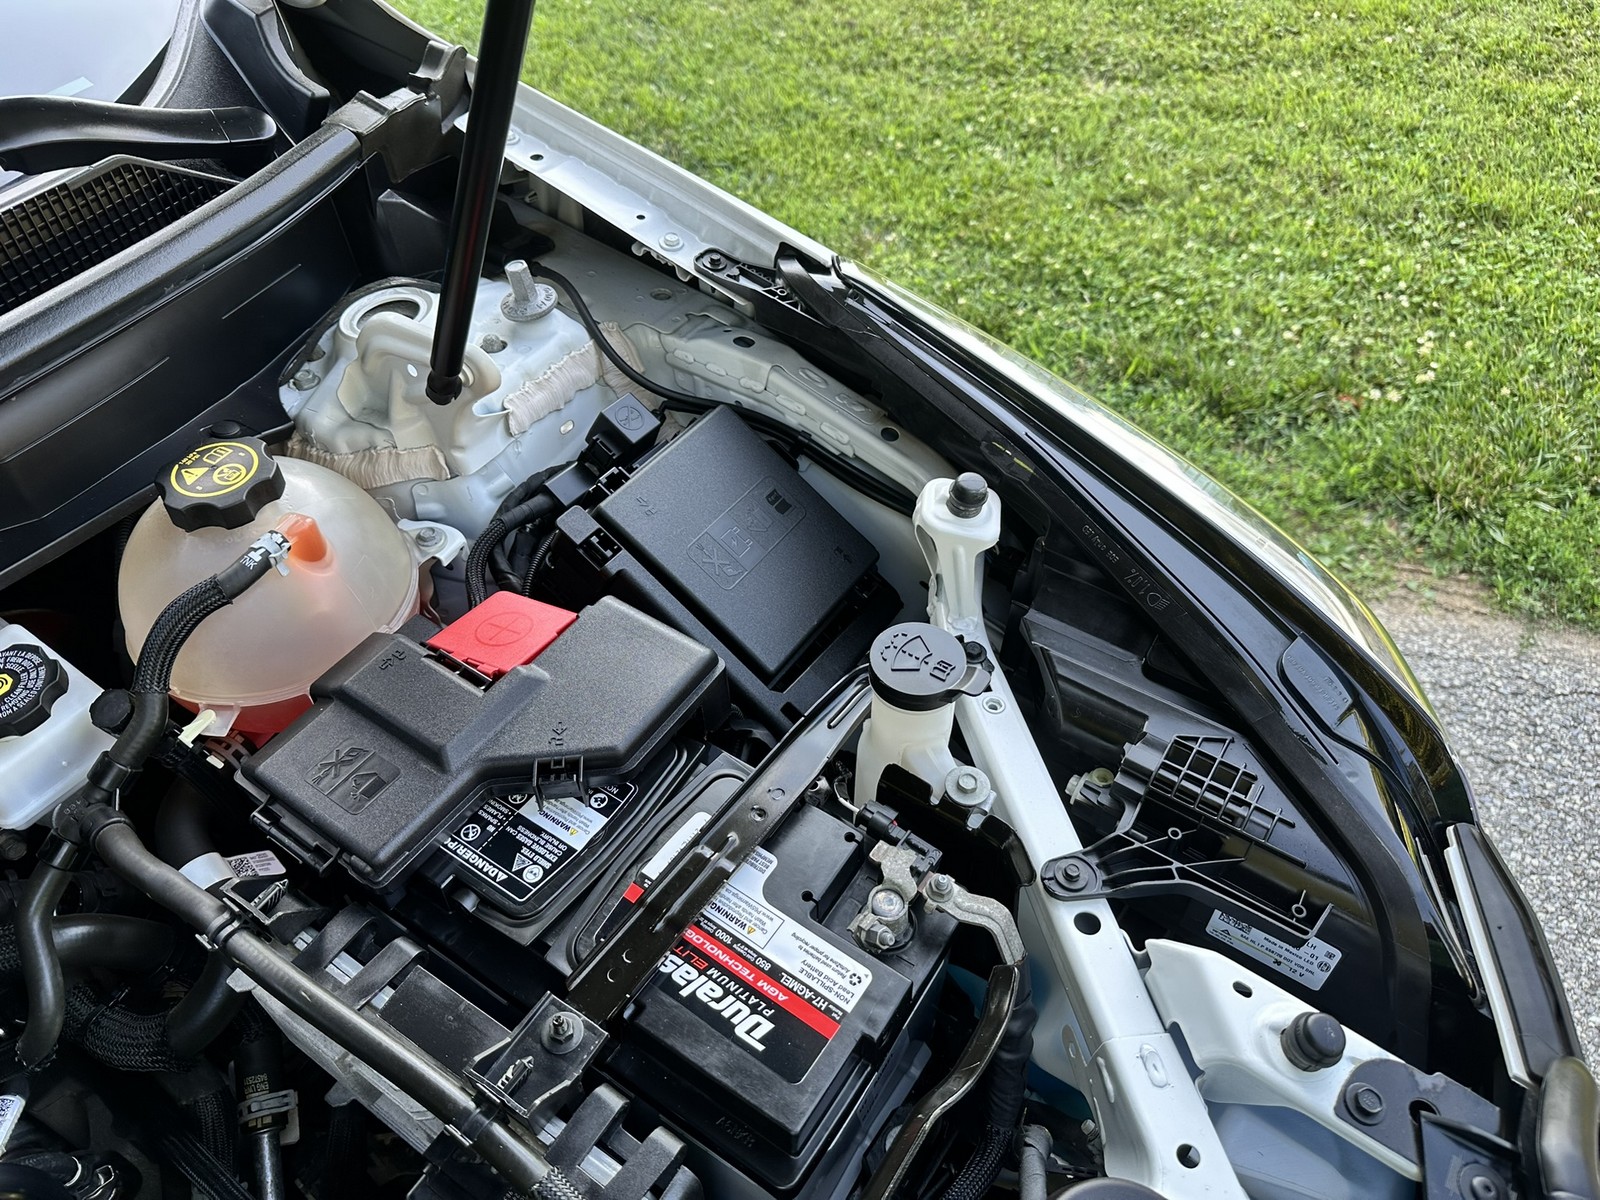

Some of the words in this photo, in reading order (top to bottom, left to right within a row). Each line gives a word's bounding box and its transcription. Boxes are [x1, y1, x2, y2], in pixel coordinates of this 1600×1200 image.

[240, 556, 258, 570] TNK
[490, 799, 509, 814] SMOKIN
[444, 837, 500, 878] DANGER/P
[709, 901, 747, 930] WARNING
[714, 928, 734, 945] 1000
[1263, 937, 1279, 947] Made
[1306, 942, 1317, 950] LH
[672, 943, 709, 971] ELIT
[682, 928, 756, 982] TECHNOLOG
[755, 955, 772, 971] 850
[800, 958, 825, 977] Battery
[706, 966, 775, 1017] PLATINUM
[756, 978, 789, 1003] AGM
[777, 972, 829, 1010] H7-AGMEL
[798, 967, 852, 1005] NON-SPILLABLE
[823, 973, 842, 989] Acid
[839, 984, 855, 998] Lead
[658, 953, 775, 1053] Duralas
